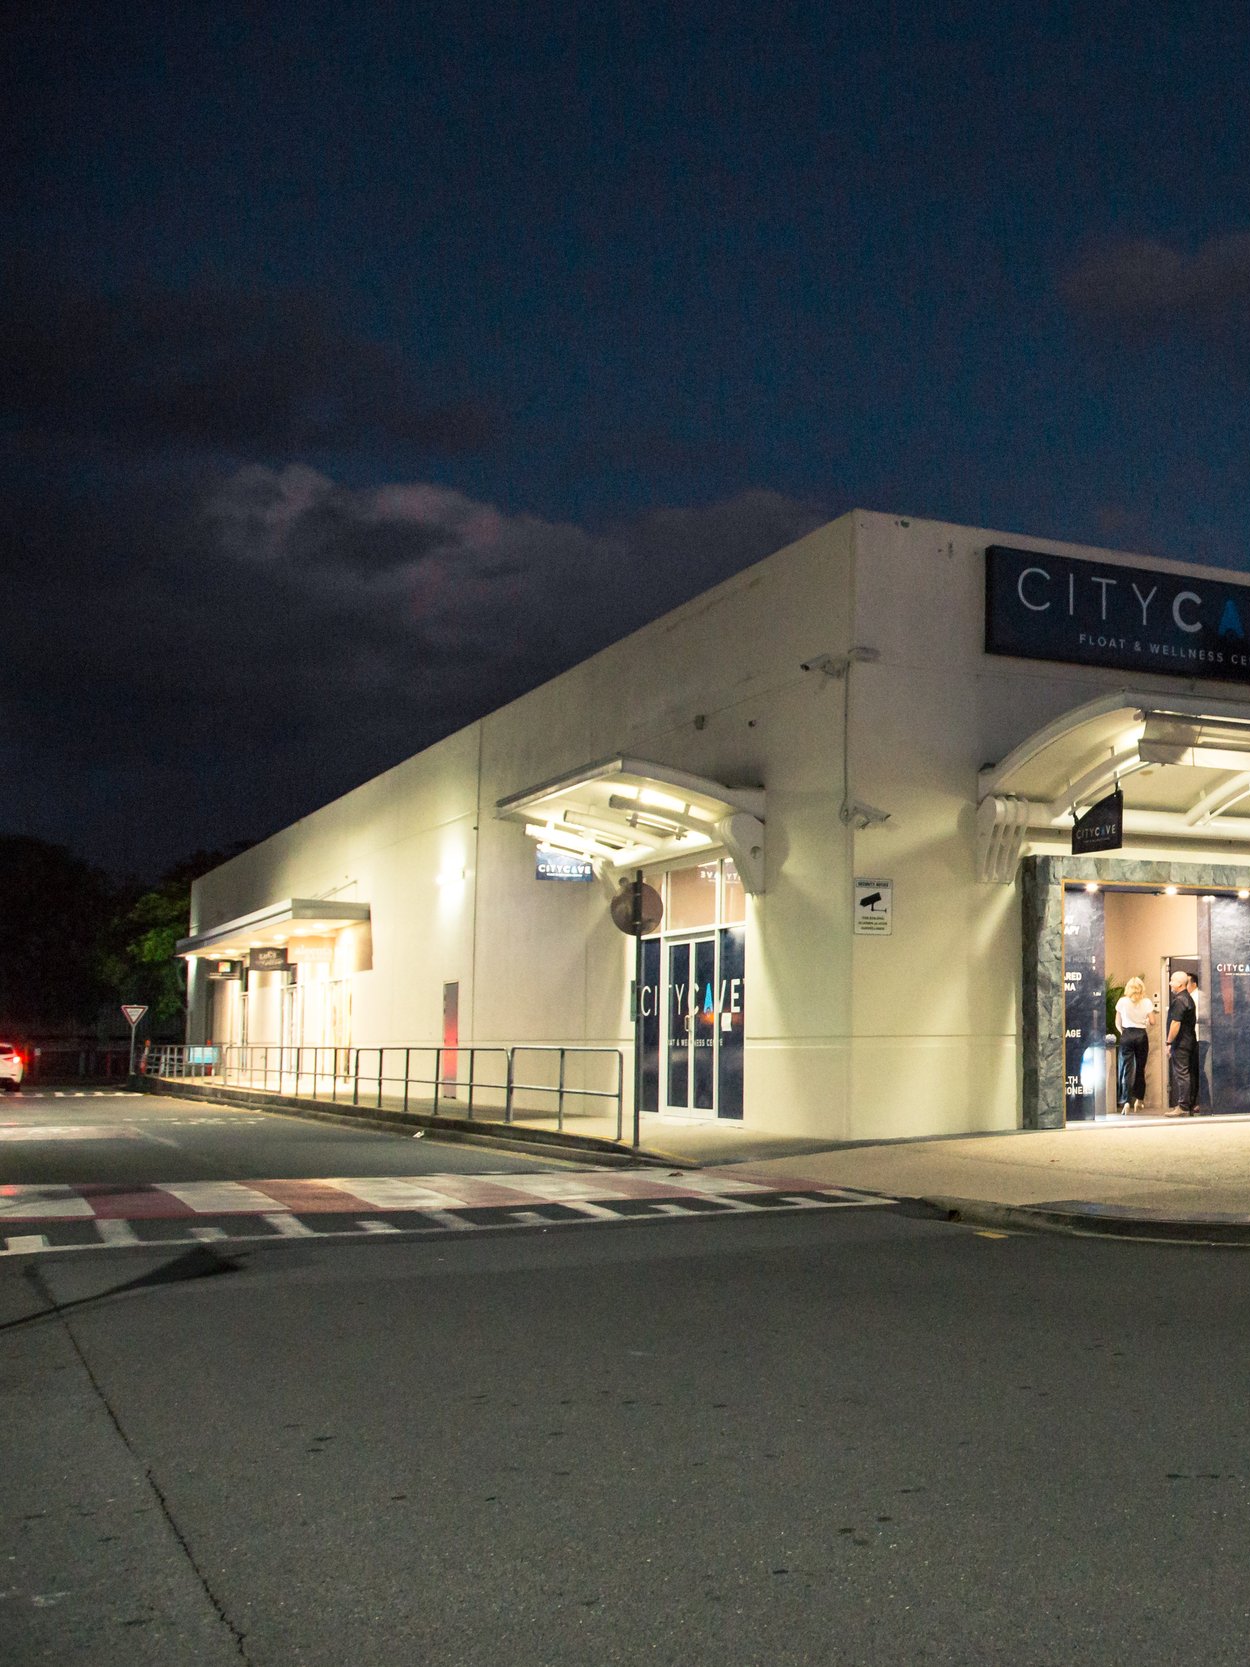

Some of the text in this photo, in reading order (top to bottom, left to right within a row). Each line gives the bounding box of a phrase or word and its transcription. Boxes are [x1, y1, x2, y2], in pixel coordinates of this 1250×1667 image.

[1079, 633, 1126, 650] FLOAT
[1133, 640, 1142, 652] &
[1150, 643, 1224, 663] WELLNESS
